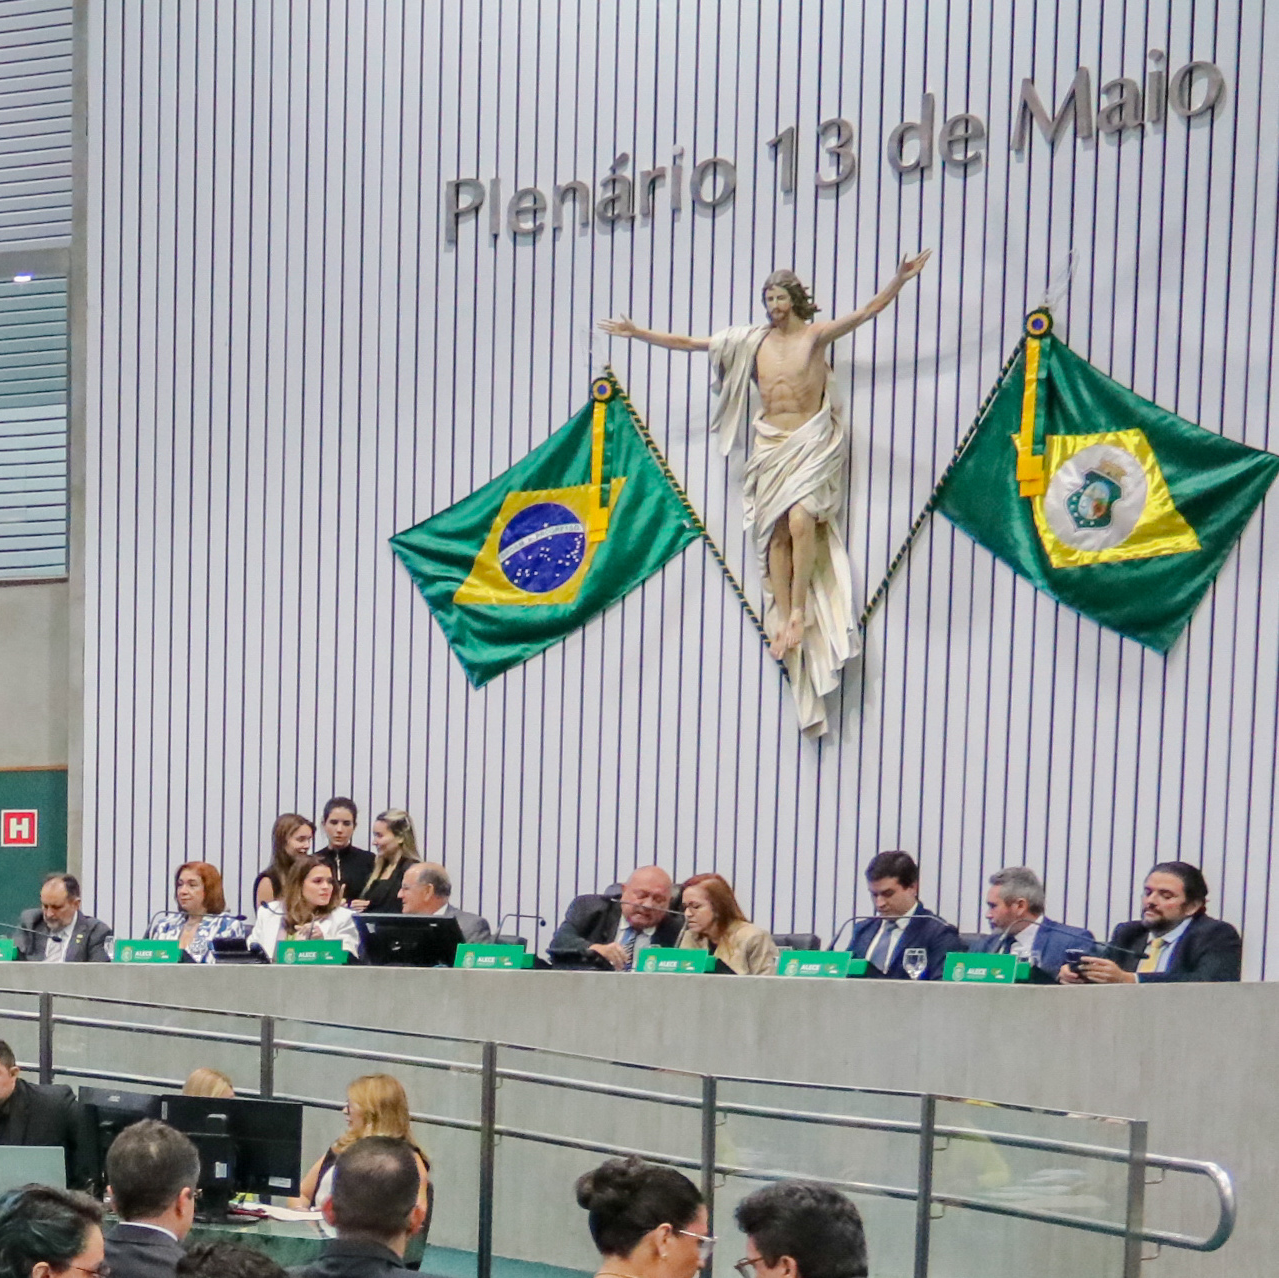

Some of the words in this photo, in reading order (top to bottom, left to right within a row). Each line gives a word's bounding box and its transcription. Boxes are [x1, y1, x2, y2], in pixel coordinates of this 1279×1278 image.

[443, 145, 737, 244] Plenário
[766, 117, 856, 195] 13
[887, 92, 985, 173] de
[1009, 48, 1227, 152] Maio
[9, 817, 30, 839] H
